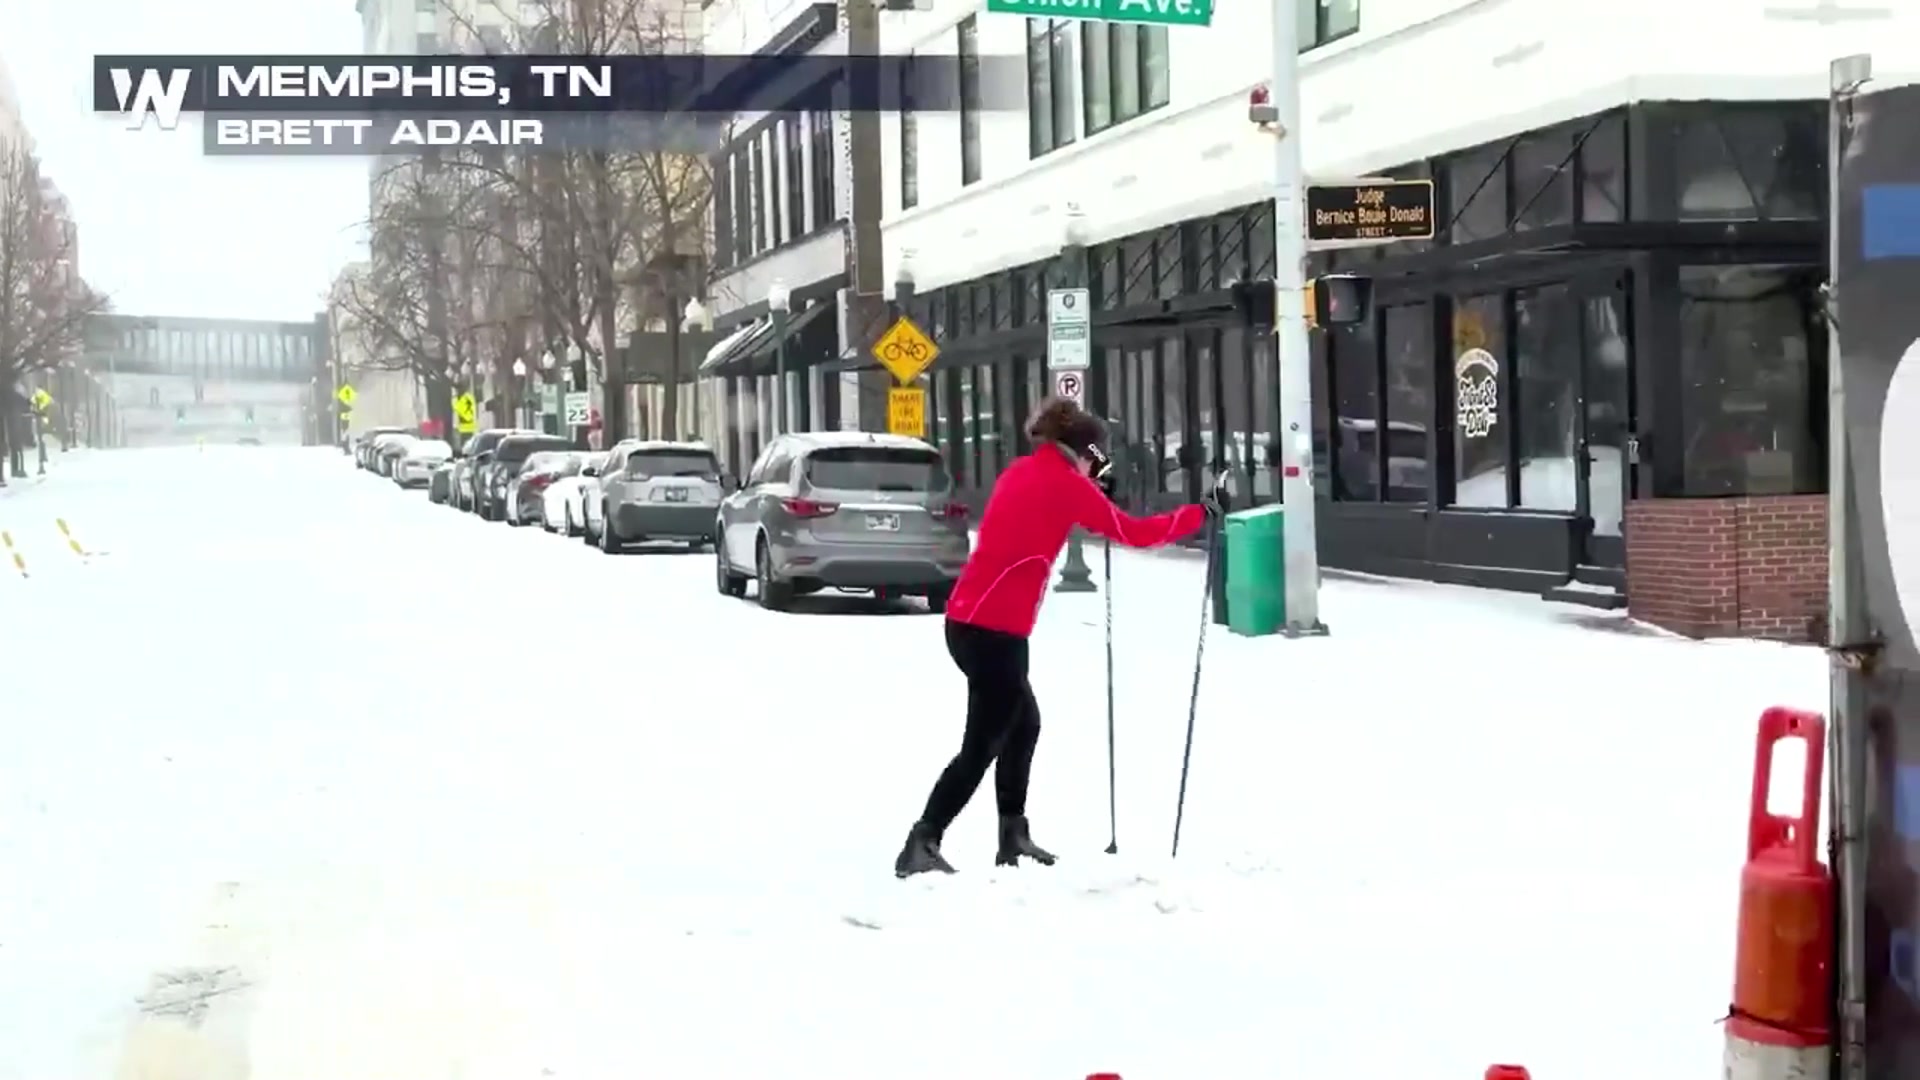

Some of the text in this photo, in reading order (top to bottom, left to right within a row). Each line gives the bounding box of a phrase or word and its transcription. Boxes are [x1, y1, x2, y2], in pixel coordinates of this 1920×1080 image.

[1355, 187, 1385, 208] Judge
[1316, 208, 1355, 226] Bernice
[1389, 205, 1425, 222] Donald
[568, 409, 589, 422] 25
